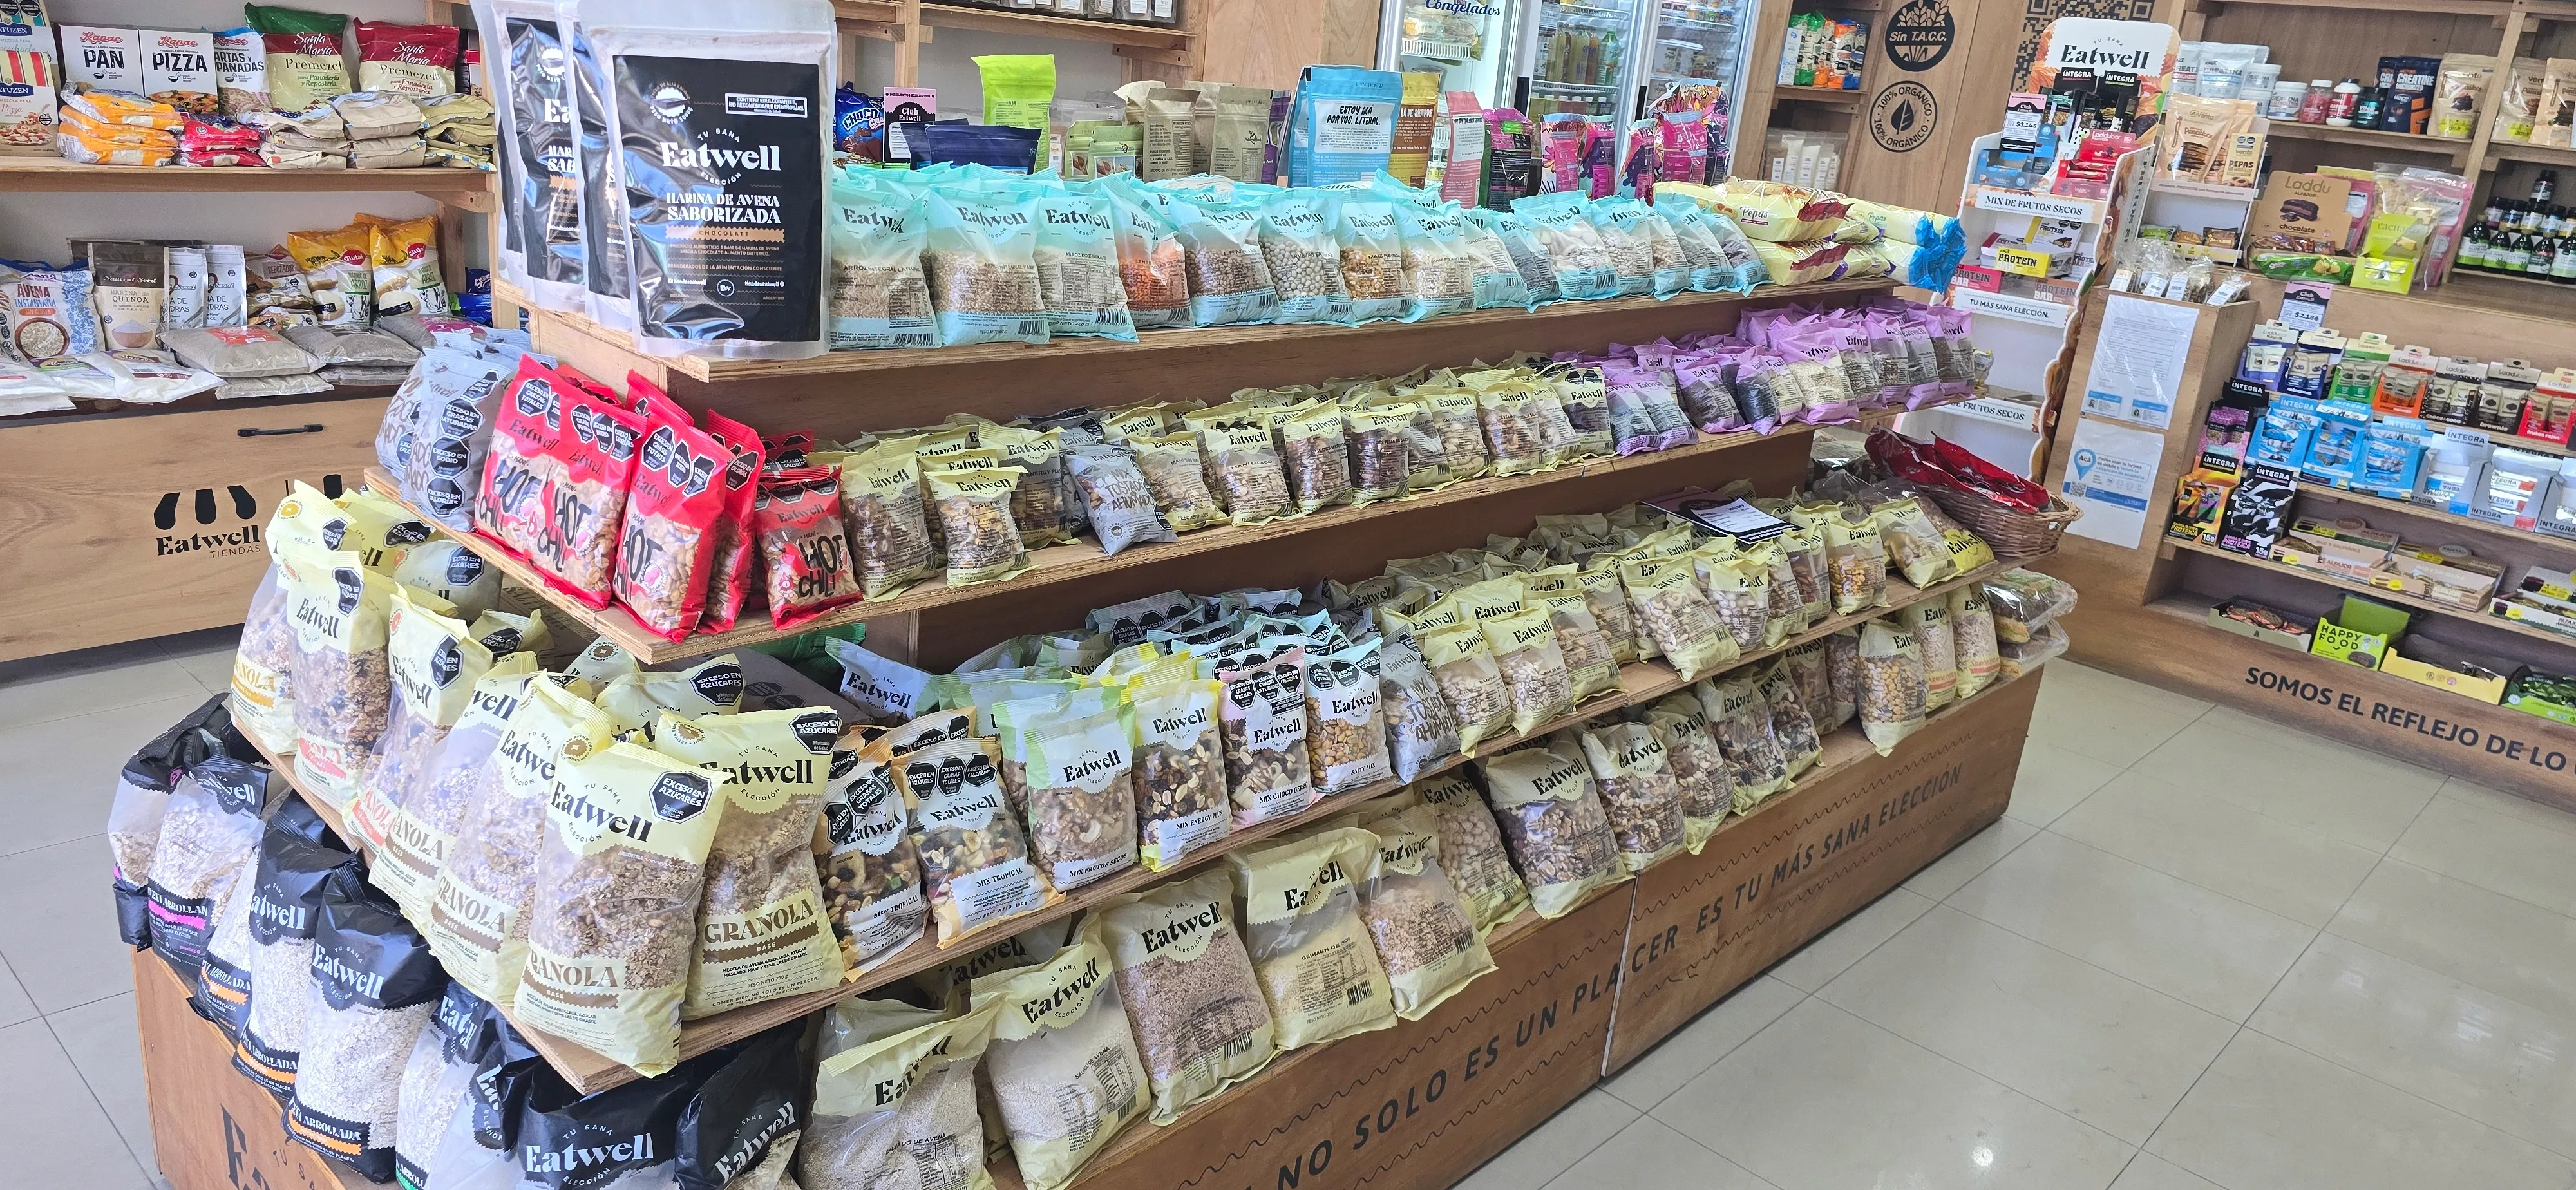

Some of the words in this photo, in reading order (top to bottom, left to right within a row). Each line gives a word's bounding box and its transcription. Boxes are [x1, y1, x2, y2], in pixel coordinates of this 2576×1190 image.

[1425, 0, 1501, 16] Congelados
[80, 32, 123, 44] Kapac
[158, 36, 198, 48] Kapac
[294, 32, 326, 45] Santa
[1889, 31, 1908, 42] Sin
[1911, 31, 1947, 42] T.A.C.C.
[2107, 37, 2124, 47] SANA
[296, 44, 333, 55] María
[393, 41, 426, 54] Santa
[84, 49, 124, 69] PAN
[153, 53, 208, 73] PIZZA
[214, 53, 245, 62] ARTAS
[391, 52, 430, 66] María
[2060, 44, 2150, 70] Eatwell
[2397, 73, 2435, 86] CREATINE
[1340, 104, 1359, 116] ESTOY
[1361, 102, 1373, 114] ACÁ
[1877, 88, 1897, 110] 100%
[1898, 86, 1933, 117] ORGÁNICO
[843, 109, 879, 131] CHOCO
[902, 107, 918, 115] Club
[1327, 115, 1339, 124] POR
[697, 130, 709, 140] TU
[1873, 118, 1888, 141] 100%
[1886, 124, 1929, 147] ORGÁNICO
[659, 142, 781, 171] Eatwell
[2228, 160, 2254, 168] PEPAS
[701, 171, 742, 185] ELECCIÓN
[2285, 176, 2331, 194] Laddu
[667, 193, 713, 205] HARINA
[716, 194, 734, 205] DE
[736, 195, 780, 207] AVENA
[1985, 196, 2003, 205] MIX
[2005, 198, 2016, 207] DE
[2018, 200, 2052, 212] FRUTOS
[2053, 205, 2083, 216] SECOS
[667, 206, 781, 224] SABORIZADA
[1046, 209, 1110, 230] Eatwell
[1739, 206, 1768, 218] Pepas
[1868, 212, 1886, 222] Pepas
[2040, 225, 2065, 234] PROTEIN
[2279, 223, 2315, 234] chocolate
[1996, 261, 2015, 270] BAR
[1998, 253, 2038, 267] PROTEIN
[1950, 277, 1969, 287] BAR
[1954, 269, 1991, 283] PROTEIN
[2033, 291, 2054, 301] BAR
[2036, 283, 2076, 296] PROTEIN
[1980, 300, 1994, 308] MÁS
[2014, 306, 2049, 318] ELECCIÓN.
[2231, 381, 2263, 394] ÍNTEGRA
[446, 404, 469, 415] EXCESO
[446, 411, 474, 423] GRASAS
[2479, 422, 2508, 432] brownie
[2448, 430, 2485, 444] ÍNTEGRA
[437, 455, 458, 464] SODIO
[2078, 455, 2091, 463] Acá
[2203, 455, 2236, 469] ÍNTEGRA
[2256, 466, 2291, 481] ÍNTEGRA
[555, 491, 592, 545] HOT
[156, 525, 260, 556] Eatwell
[537, 526, 565, 572] CHILI
[210, 544, 261, 559] TIENDAS
[621, 522, 663, 581] HOT
[801, 535, 843, 574] HOT
[799, 572, 836, 598] CHILI
[296, 598, 339, 639] Eatwell
[1513, 619, 1553, 644] Eatwell
[2320, 623, 2362, 642] HAPPY
[2318, 633, 2359, 651] FOOD
[1332, 689, 1378, 716] Eatwell
[796, 720, 828, 729] EXCESO
[829, 719, 840, 727] EN
[1151, 707, 1208, 735] Eatwell
[2245, 666, 2334, 705] SOMOS
[2336, 692, 2365, 717] EL
[2371, 701, 2479, 748] REFLEJO
[2485, 733, 2524, 761] DE
[2528, 746, 2566, 772] LO
[799, 725, 839, 735] AZÚCARES
[1253, 717, 1302, 744] Eatwell
[1063, 749, 1122, 782] Eatwell
[1350, 766, 1365, 776] SALTY
[1366, 762, 1376, 771] MIX
[603, 785, 621, 805] SANA
[659, 785, 703, 806] AZÚCARES
[663, 777, 693, 796] EXCESO
[691, 787, 705, 799] EN
[741, 788, 780, 802] ELECCIÓN
[856, 784, 876, 804] GRASAS
[1259, 794, 1271, 804] MIX
[1273, 789, 1293, 800] CHOCO
[858, 789, 882, 809] TOTALES
[930, 793, 998, 822] Eatwell
[551, 780, 653, 843] Eatwell
[1176, 820, 1189, 830] MIX
[1190, 814, 1211, 826] ENERGY
[1212, 809, 1223, 820] PLUS
[568, 822, 603, 843] ELECCIÓN
[1069, 865, 1083, 877] MIX
[1084, 859, 1110, 874] FRUTOS
[1110, 852, 1128, 865] SECOS
[976, 878, 991, 888] MIX
[992, 867, 1023, 885] TROPICAL
[703, 898, 815, 945] GRANOLA
[1141, 902, 1223, 954] Eatwell
[756, 942, 777, 952] BASE
[1302, 948, 1329, 961] GERMEN
[1330, 943, 1340, 952] DE
[312, 944, 385, 1000] Eatwell
[531, 950, 619, 988] RANOLA
[1276, 1139, 1332, 1190] NO
[1352, 1068, 1447, 1150] SOLO
[1464, 1036, 1500, 1082] ES
[1515, 1001, 1558, 1048] UN
[1572, 924, 1678, 1014] PLACER
[1696, 896, 1722, 933] ES
[1732, 874, 1761, 911] TU
[1770, 843, 1812, 892] MÁS
[1821, 812, 1870, 859] SANA
[1877, 762, 1964, 829] ELECCIÓN
[546, 989, 564, 999] BASE
[1021, 956, 1101, 1025] Eatwell
[1054, 996, 1086, 1019] ELECCIÓN
[303, 1115, 361, 1141] ARROLLADA
[563, 1127, 580, 1140] TU
[584, 1124, 613, 1136] SANA
[924, 1133, 946, 1144] AVENA
[525, 1133, 654, 1173] Eatwell
[563, 1167, 611, 1187] ELECCIÓN
